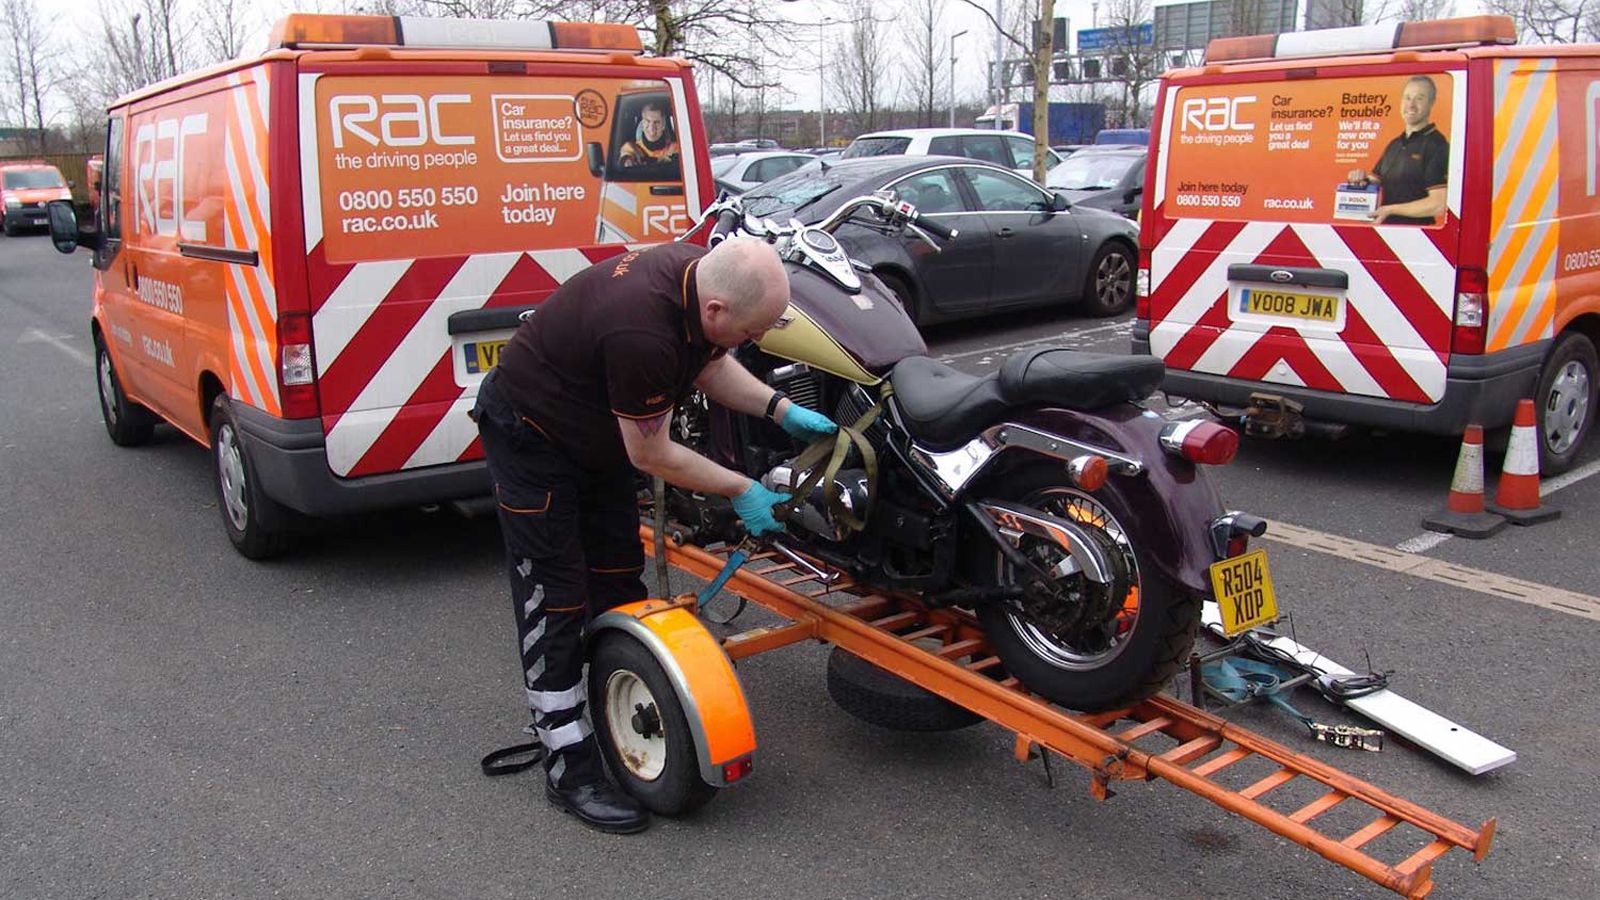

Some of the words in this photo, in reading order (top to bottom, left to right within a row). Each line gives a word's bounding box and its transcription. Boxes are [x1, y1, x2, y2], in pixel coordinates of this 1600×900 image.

[1272, 95, 1292, 106] Car
[1342, 93, 1388, 106] Battery
[501, 102, 525, 116] Car
[1181, 96, 1256, 131] RAC
[1271, 106, 1333, 119] insurance?
[1340, 105, 1392, 118] trouble?
[330, 94, 475, 148] RAC
[503, 115, 572, 130] insurance?
[1270, 121, 1283, 131] Let
[1284, 123, 1294, 131] us
[1295, 121, 1312, 131] find
[1338, 120, 1360, 130] We'll
[1361, 120, 1372, 130] fit
[1373, 122, 1380, 130] a
[504, 131, 520, 142] Let
[521, 133, 533, 141] us
[534, 131, 552, 141] find
[553, 133, 571, 143] you
[1181, 133, 1194, 144] the
[1195, 133, 1222, 146] driving
[1223, 132, 1254, 146] people
[1269, 133, 1284, 142] you
[513, 144, 538, 155] great
[540, 143, 567, 153] deal...
[1268, 140, 1290, 151] great
[1291, 139, 1309, 149] deal
[1337, 140, 1351, 149] for
[1351, 141, 1369, 151] you
[335, 152, 362, 169] the
[366, 151, 420, 170] driving
[424, 149, 477, 169] people
[133, 113, 208, 241] RAC
[500, 183, 540, 203] Join
[543, 183, 585, 200] here
[1178, 181, 1196, 192] Join
[1198, 181, 1219, 192] here
[1221, 182, 1248, 195] today
[339, 190, 393, 211] 0800
[398, 188, 436, 208] 550
[441, 186, 479, 206] 550
[1177, 194, 1200, 206] 0800
[1201, 194, 1220, 206] 550
[1221, 195, 1241, 207] 550
[1264, 197, 1313, 209] rac.co.uk
[342, 210, 439, 233] rac.co.uk
[502, 205, 556, 225] today
[1565, 252, 1588, 271] 0800
[1300, 298, 1333, 318] JWA
[1222, 558, 1263, 597] R504
[1233, 589, 1264, 625] XOP
